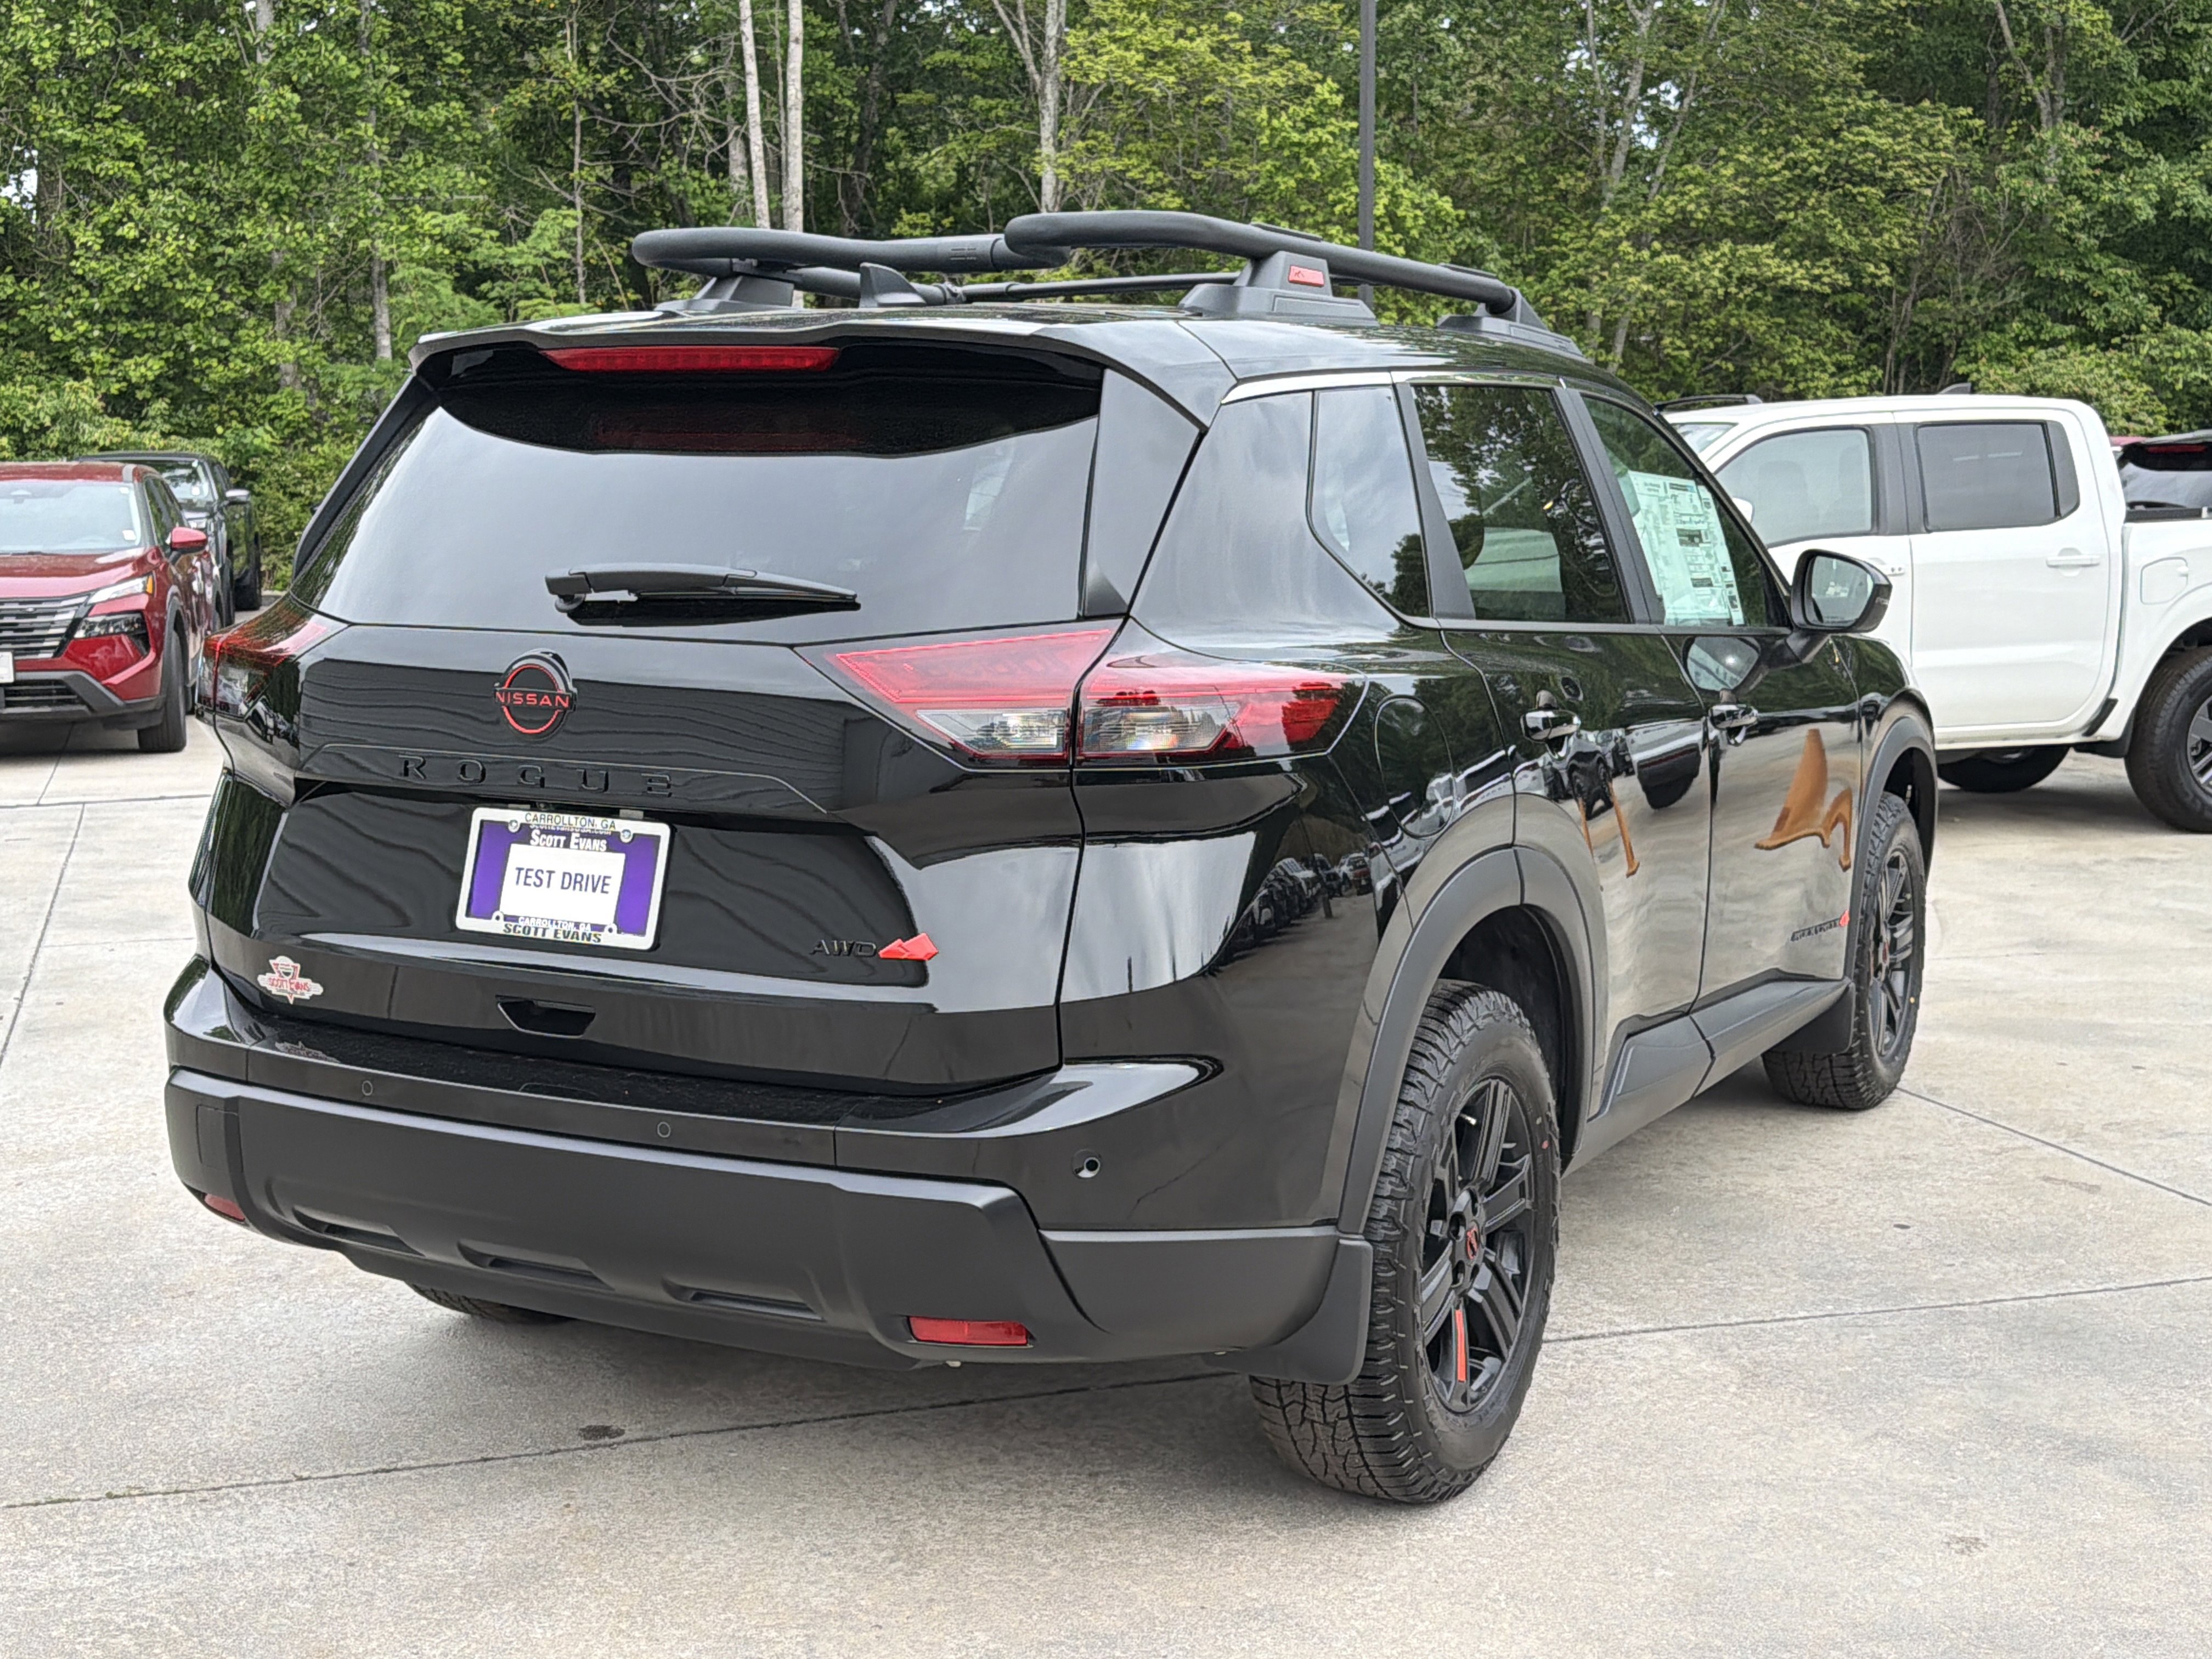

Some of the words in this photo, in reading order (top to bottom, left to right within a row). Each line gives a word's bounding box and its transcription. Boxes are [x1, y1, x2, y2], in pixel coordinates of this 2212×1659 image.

[495, 691, 569, 708] NISSAN
[398, 754, 673, 798] ROGUE
[601, 819, 616, 830] GA
[515, 867, 556, 889] TEST
[560, 871, 612, 894] DRIVE
[503, 923, 549, 938] SCOTT
[554, 928, 602, 943] EVANS
[809, 939, 877, 957] AWD
